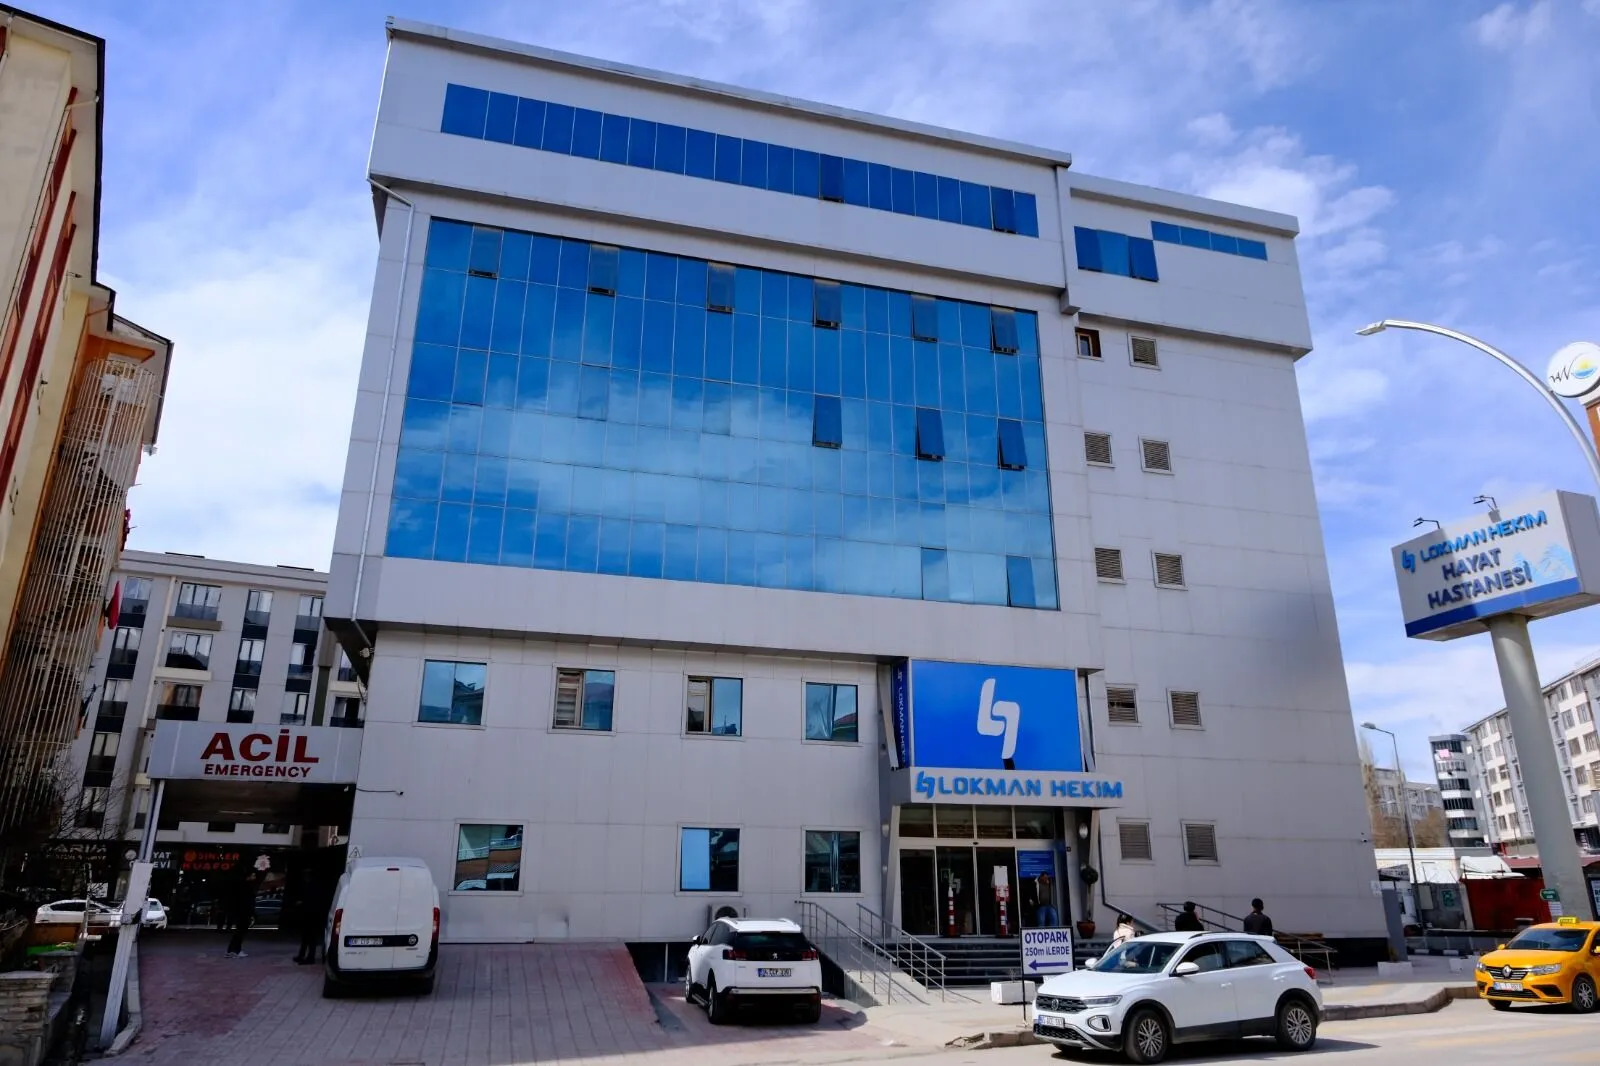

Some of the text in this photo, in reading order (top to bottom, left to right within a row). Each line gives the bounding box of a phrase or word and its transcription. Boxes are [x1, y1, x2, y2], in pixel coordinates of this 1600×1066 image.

[1420, 529, 1488, 563] LOKMAN
[1442, 548, 1502, 580] HAYAT
[200, 728, 319, 764] ACİL
[204, 764, 311, 777] EMERGENCY
[938, 776, 1042, 797] LOKMAN
[1024, 931, 1068, 944] OTOPARK
[1025, 946, 1044, 956] 250m
